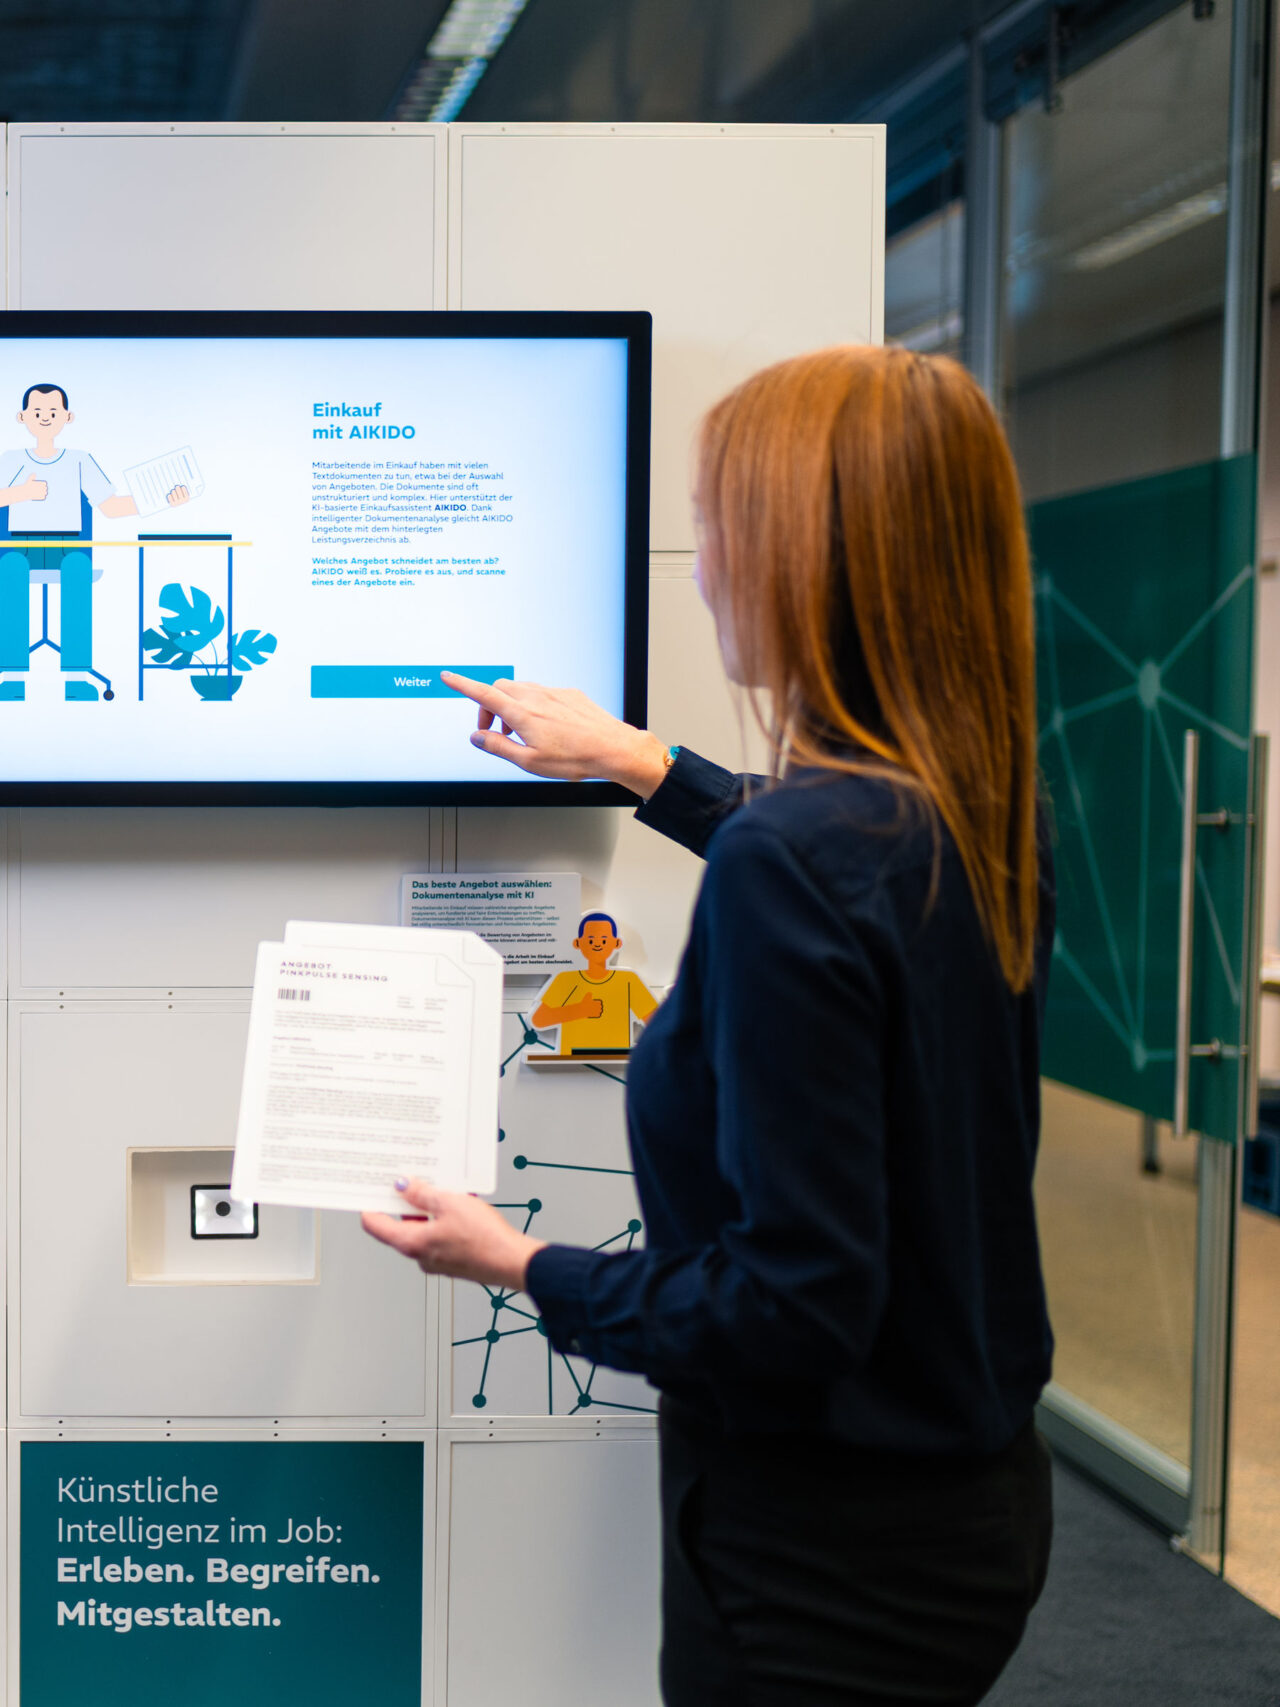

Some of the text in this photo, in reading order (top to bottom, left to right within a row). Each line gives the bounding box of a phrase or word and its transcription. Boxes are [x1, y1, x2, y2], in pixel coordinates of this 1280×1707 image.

[313, 402, 382, 417] Einkauf
[312, 424, 416, 440] mit AIKIDO
[312, 461, 372, 470] Mitarbeitende
[386, 461, 418, 470] Einkauf
[420, 461, 446, 470] haben
[447, 462, 462, 470] mit
[312, 472, 382, 480] Textdokumenten
[438, 472, 451, 480] bei
[469, 472, 504, 480] Auswahl
[329, 482, 378, 493] Angeboten.
[380, 482, 394, 491] Die
[396, 482, 445, 491] Dokumente
[446, 482, 464, 491] sind
[466, 482, 480, 491] oft
[312, 492, 370, 502] unstrukturiert
[372, 493, 388, 502] und
[390, 493, 427, 502] komplex.
[450, 494, 498, 502] unterstützt
[498, 493, 513, 502] der
[360, 504, 432, 512] Einkaufsassistent
[434, 504, 469, 512] AIKIDO.
[312, 514, 514, 524] intelligenter Dokumentenanalyse gleicht AIKIDO
[312, 525, 352, 534] Angebote
[392, 525, 443, 534] hinterlegten
[312, 536, 397, 545] Leistungsverzeichnis
[350, 557, 389, 567] Angebot
[312, 578, 334, 586] eines
[354, 578, 397, 588] Angebote
[394, 677, 432, 686] Weiter
[431, 880, 457, 889] beste
[459, 880, 499, 890] Angebot
[501, 880, 552, 888] auswählen:
[412, 891, 504, 900] Dokumentenanalyse
[507, 891, 522, 899] mit
[280, 969, 388, 982] PINKPULSE SENSING
[58, 1476, 218, 1503] Künstliche
[58, 1516, 342, 1550] Intelligenz im Job:
[58, 1556, 380, 1590] Erleben. Begreifen.
[58, 1598, 281, 1633] Mitgestalten.
